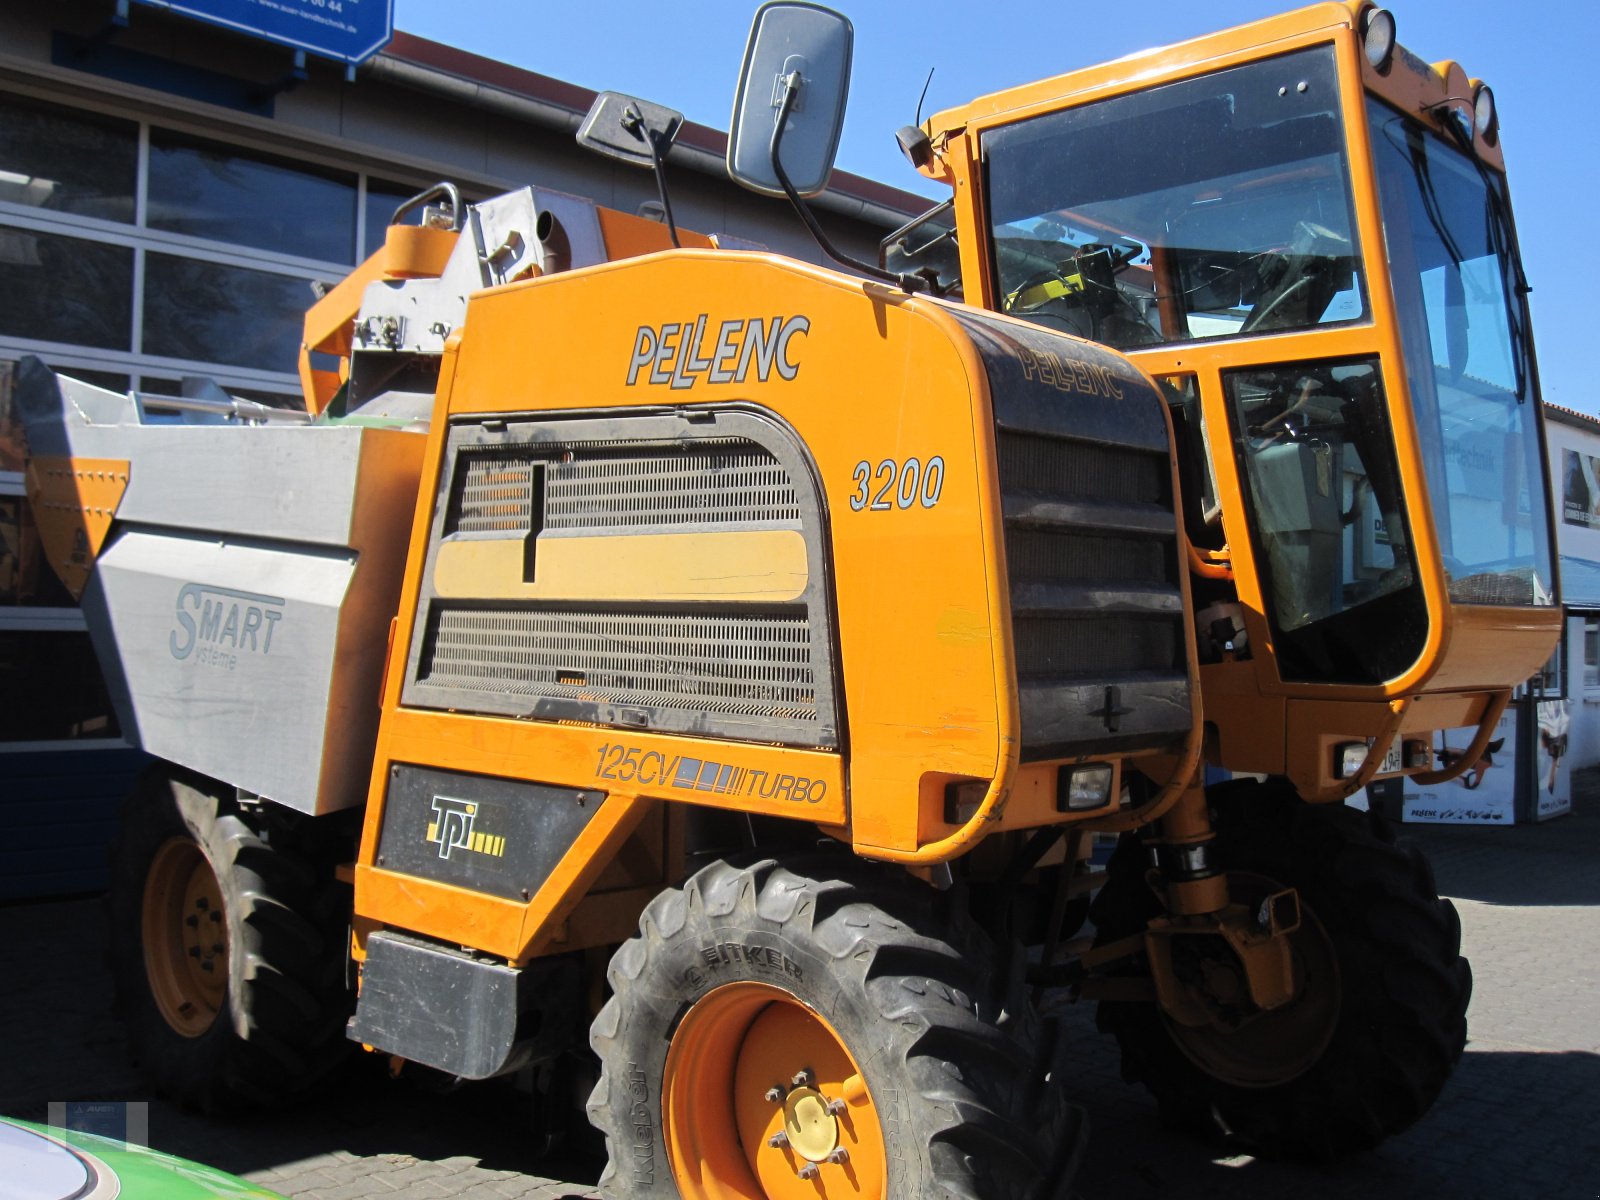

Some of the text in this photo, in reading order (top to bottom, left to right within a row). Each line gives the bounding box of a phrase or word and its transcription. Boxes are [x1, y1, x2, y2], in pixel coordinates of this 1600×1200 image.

[328, 0, 343, 13] 44
[625, 313, 811, 390] PELLENC
[1015, 348, 1124, 400] PELLENC
[849, 455, 945, 512] 3200
[169, 582, 286, 660] SMART
[595, 743, 827, 804] 125CV TURBO
